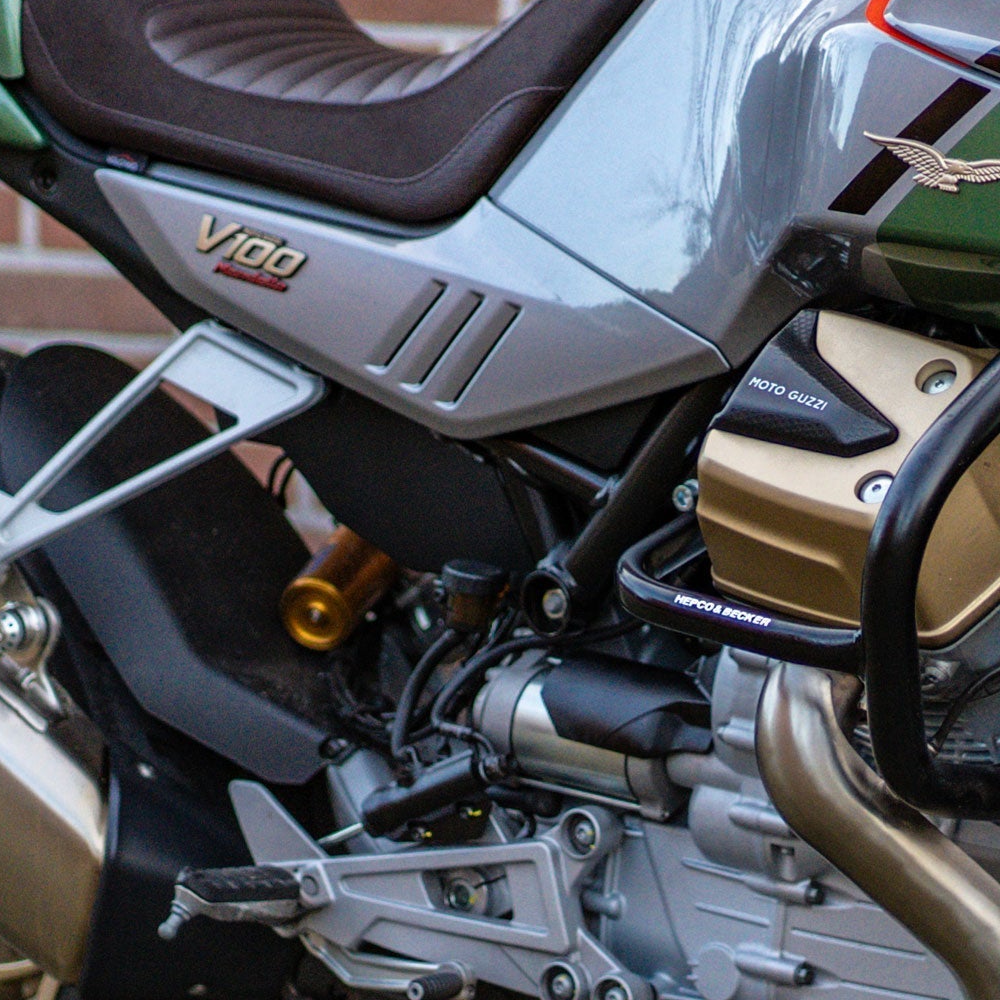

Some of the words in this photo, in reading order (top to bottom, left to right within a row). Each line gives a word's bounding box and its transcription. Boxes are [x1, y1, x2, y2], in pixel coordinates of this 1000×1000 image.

[196, 213, 308, 279] V100
[748, 376, 786, 396] MOTO
[787, 390, 829, 411] GUZZI
